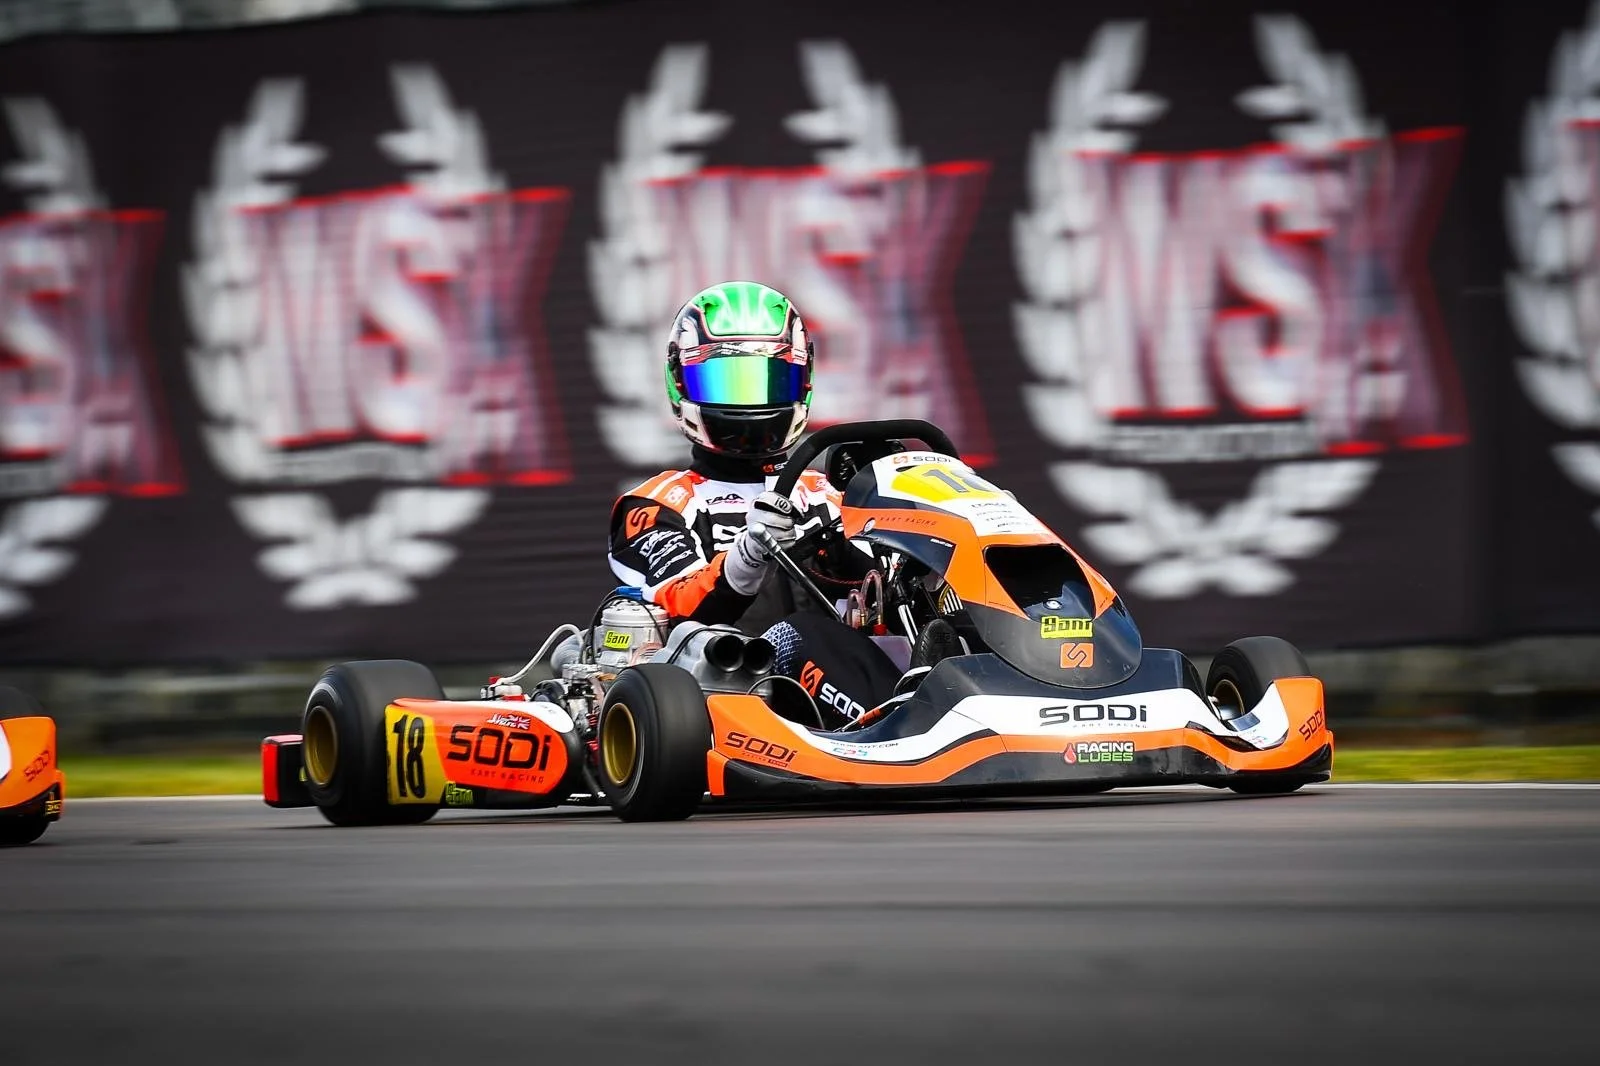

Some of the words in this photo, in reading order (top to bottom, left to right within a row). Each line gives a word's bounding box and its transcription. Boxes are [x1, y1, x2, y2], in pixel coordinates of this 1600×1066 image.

[1077, 741, 1134, 753] RACING
[393, 714, 427, 799] 18
[1078, 752, 1133, 763] LUBES
[470, 768, 497, 778] KART
[501, 772, 545, 784] RACING
